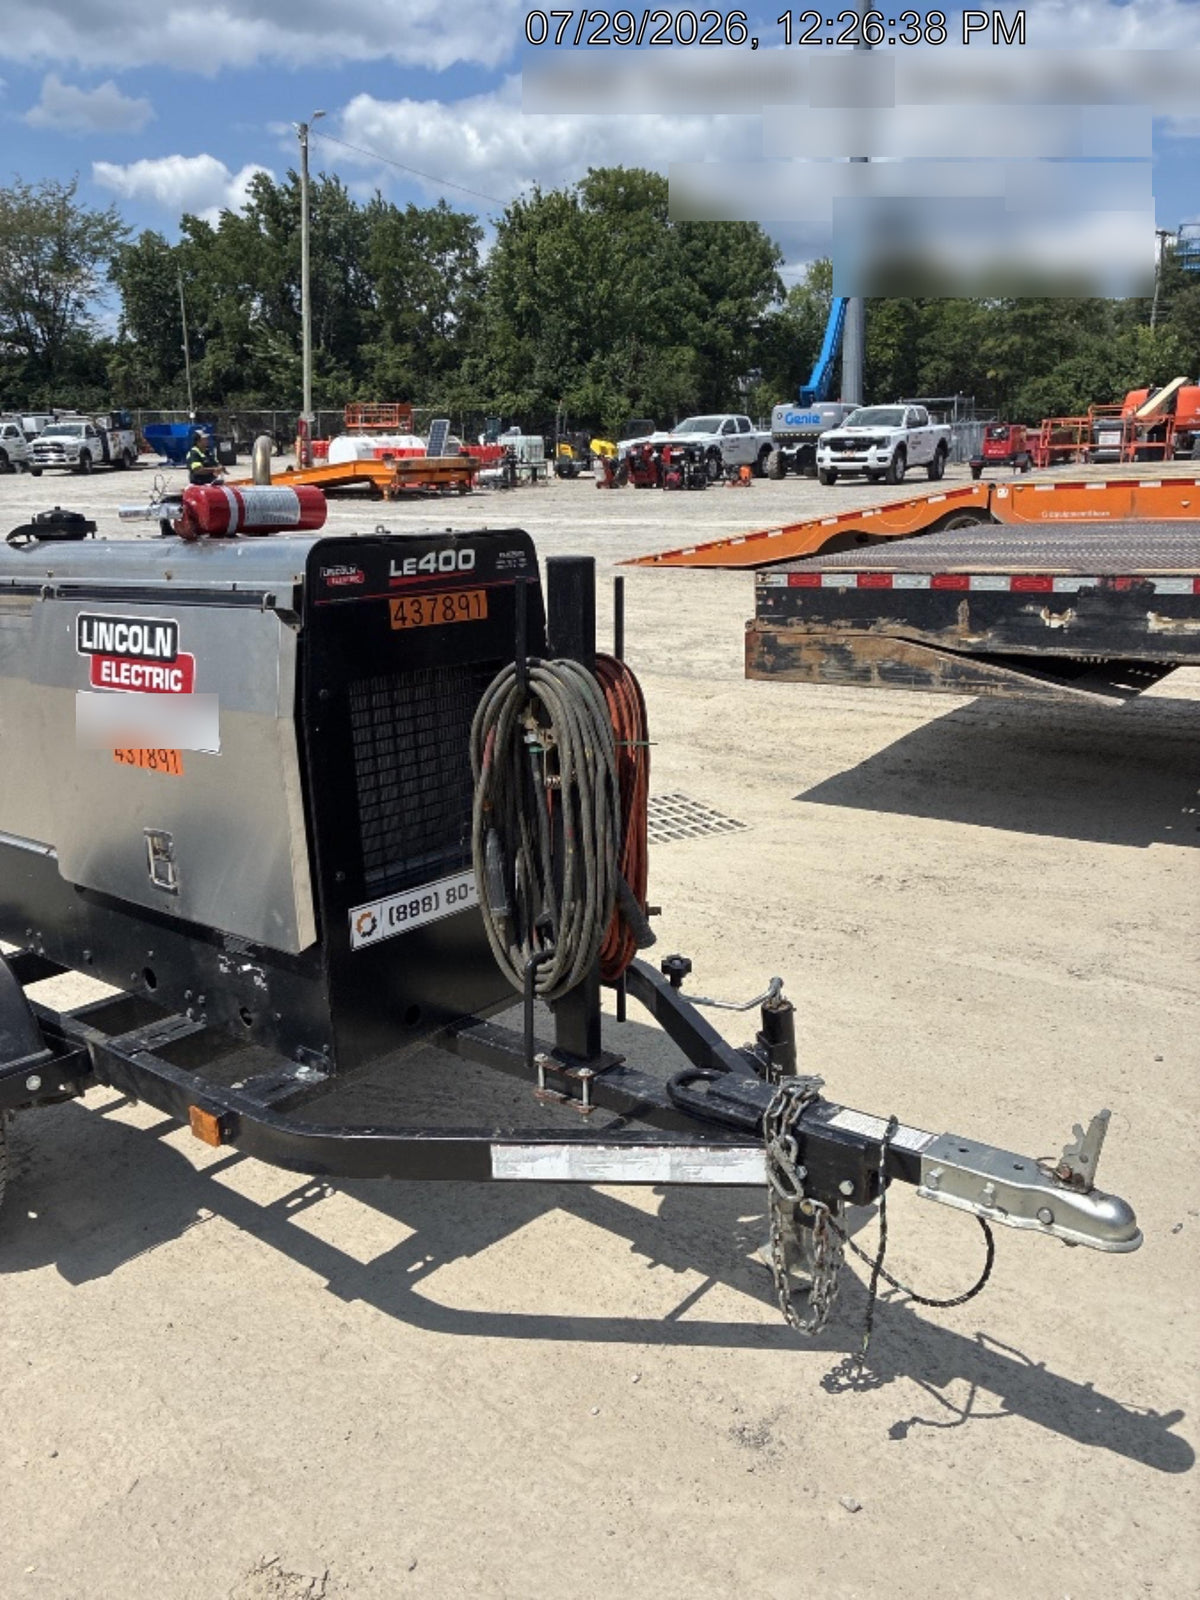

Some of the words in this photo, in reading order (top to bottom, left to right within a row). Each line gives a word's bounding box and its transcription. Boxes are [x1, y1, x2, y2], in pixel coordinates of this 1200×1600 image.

[785, 412, 821, 425] Genie
[389, 549, 476, 577] LE400
[393, 592, 482, 626] 437891
[81, 619, 172, 657] LINCOLN
[100, 661, 183, 692] ELECTRIC
[388, 892, 440, 926] (888)
[445, 884, 480, 905] 80-
